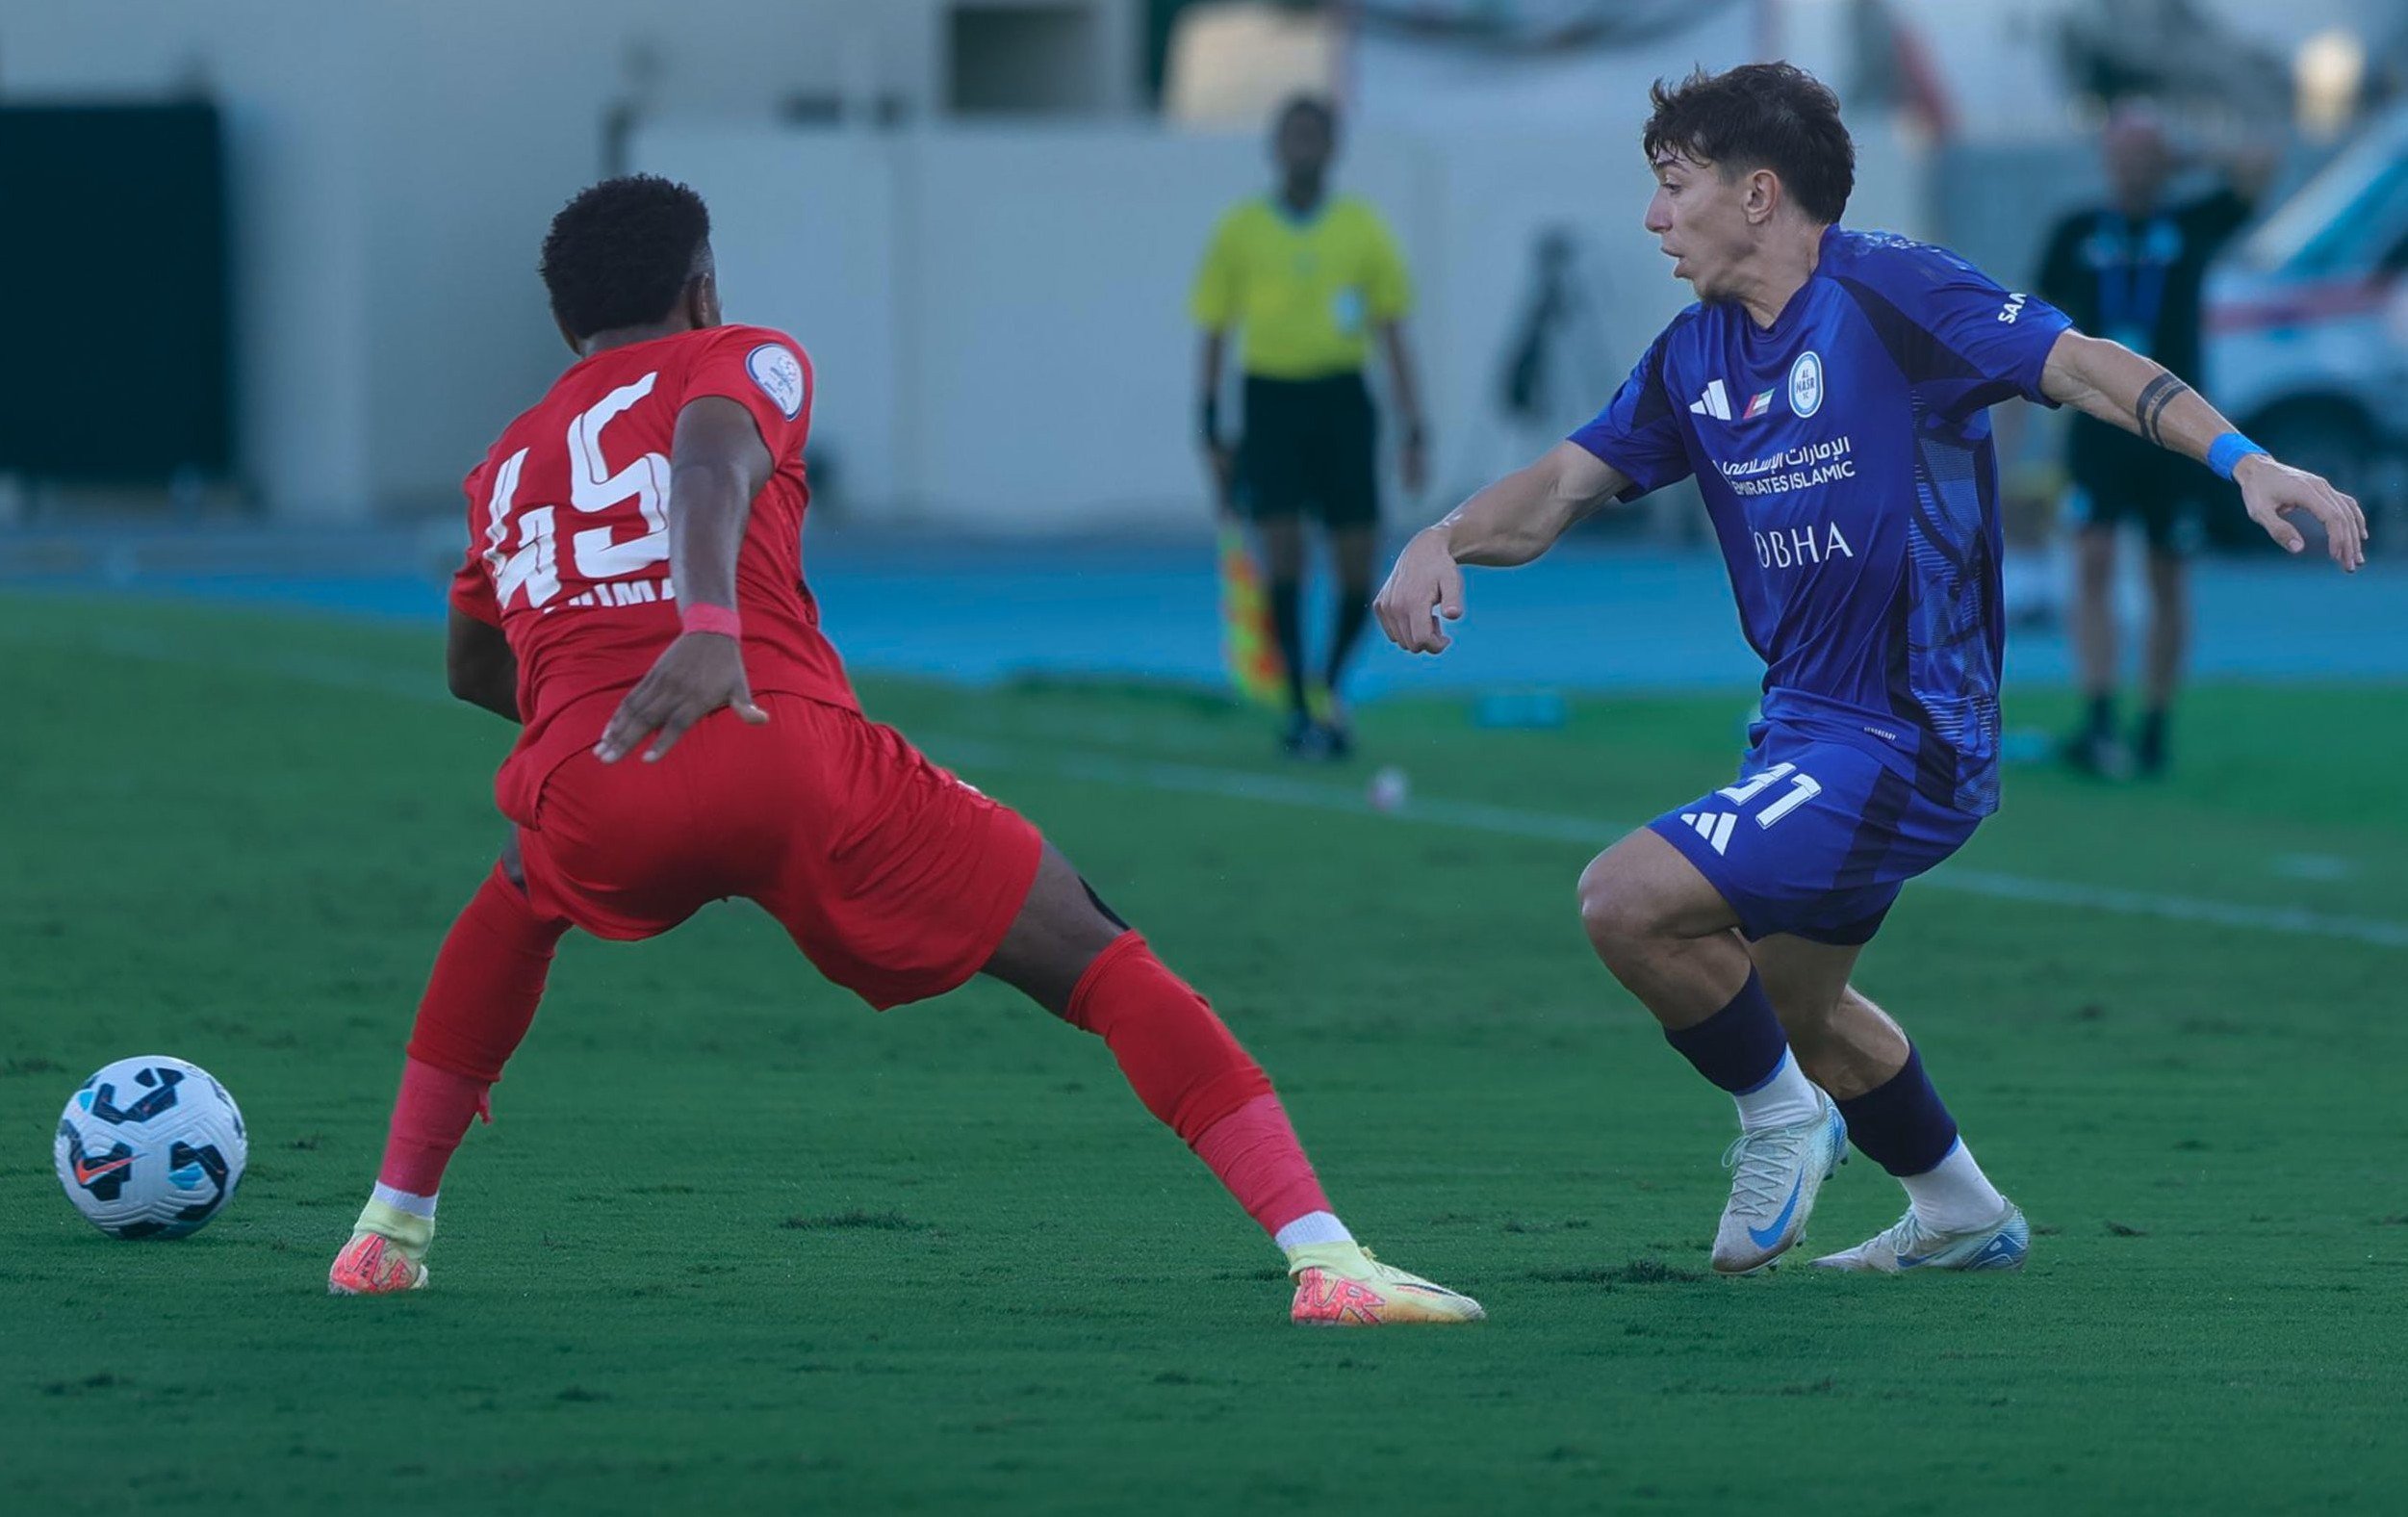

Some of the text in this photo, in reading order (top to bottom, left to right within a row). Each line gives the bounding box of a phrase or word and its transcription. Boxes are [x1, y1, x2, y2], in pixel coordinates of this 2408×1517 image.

[1796, 376, 1815, 394] NASR
[483, 372, 673, 610] 45
[1789, 461, 1856, 490] ISLAMIC
[1754, 521, 1855, 569] OBHA
